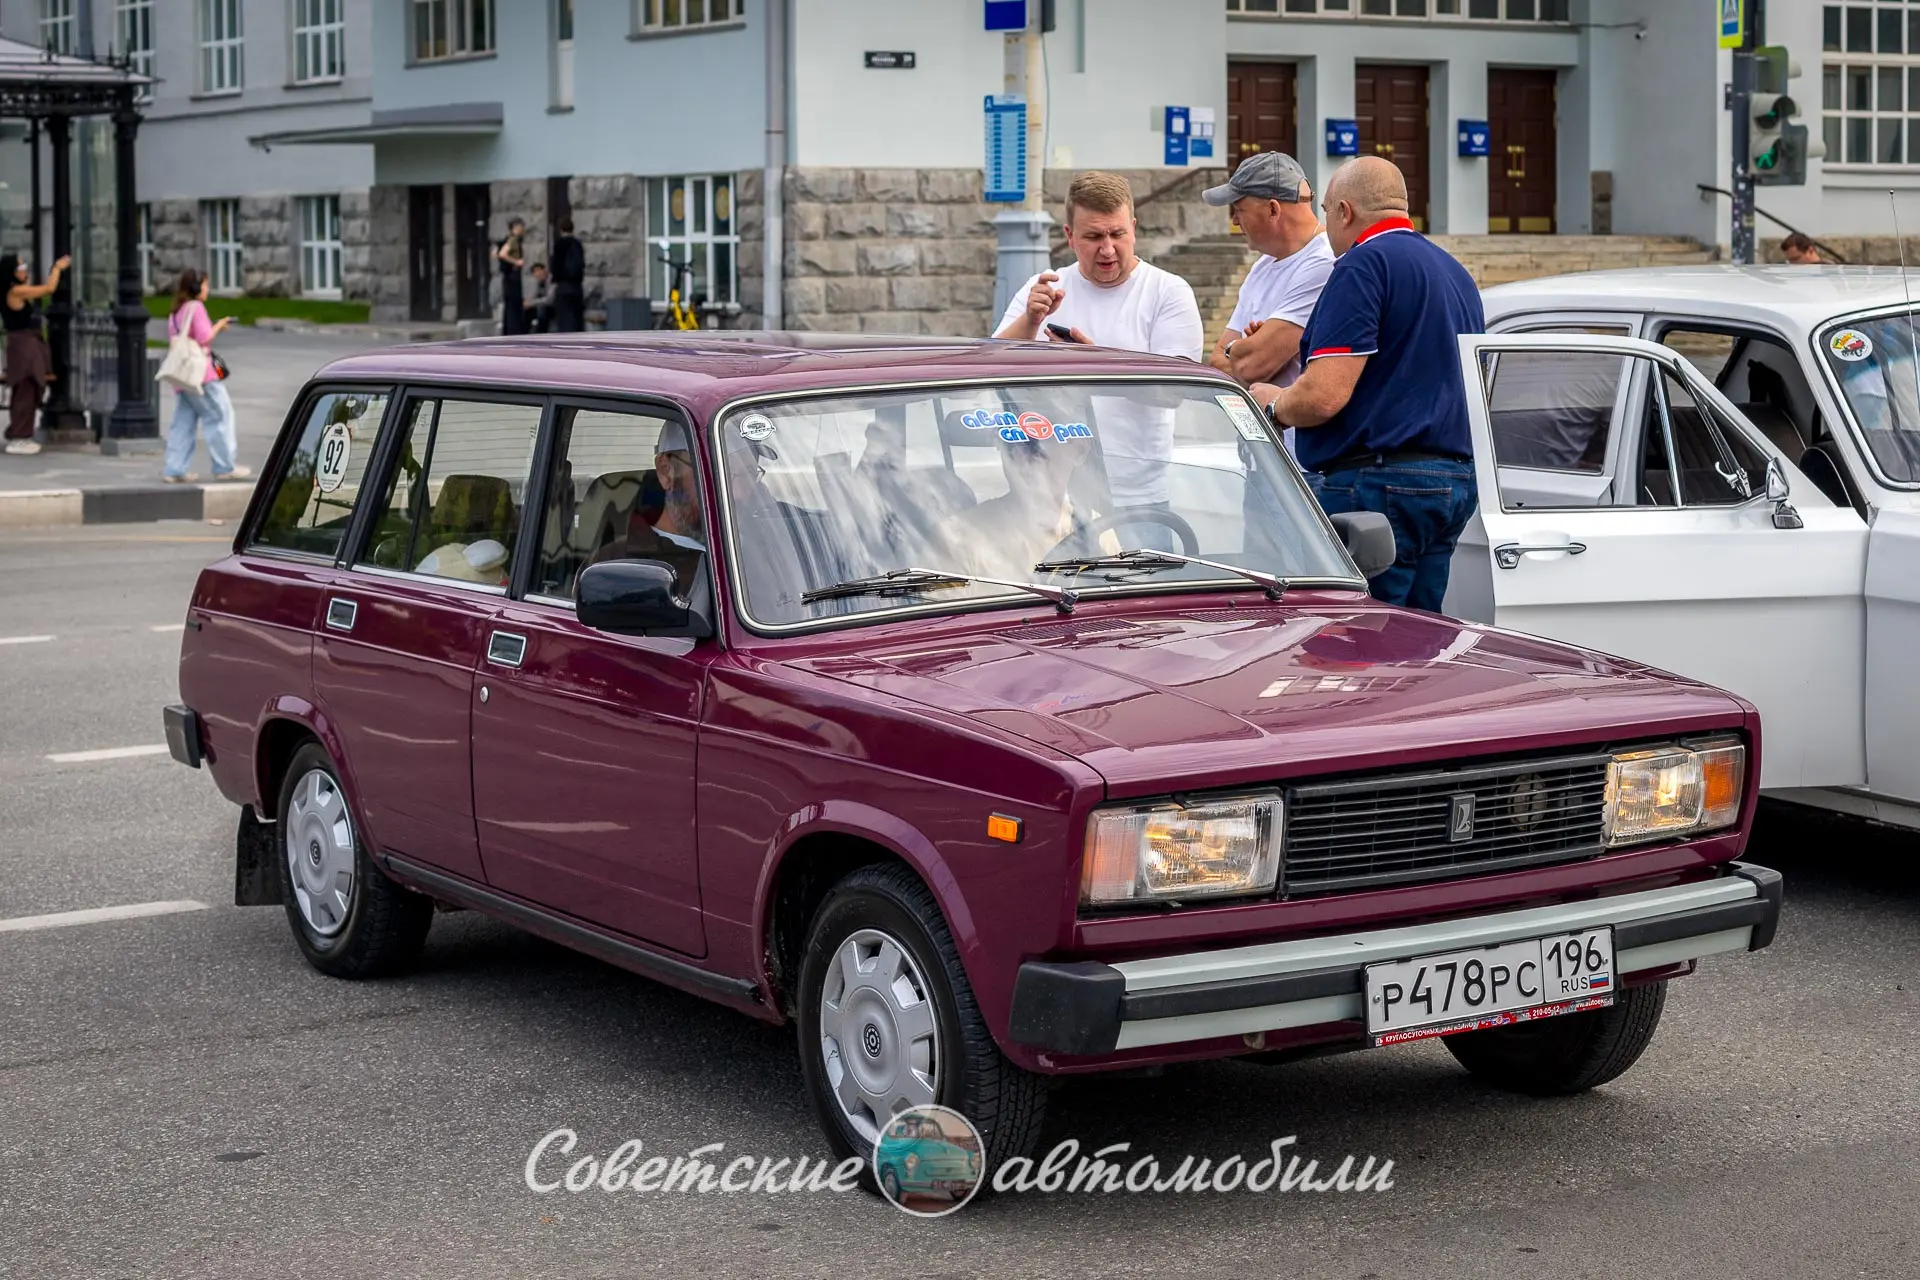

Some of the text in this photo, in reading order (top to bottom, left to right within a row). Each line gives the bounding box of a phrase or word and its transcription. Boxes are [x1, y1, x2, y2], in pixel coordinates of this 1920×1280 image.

[323, 439, 344, 475] 92
[1547, 935, 1602, 978] 196
[1382, 958, 1538, 1022] Р478РС
[1561, 976, 1588, 993] RUS
